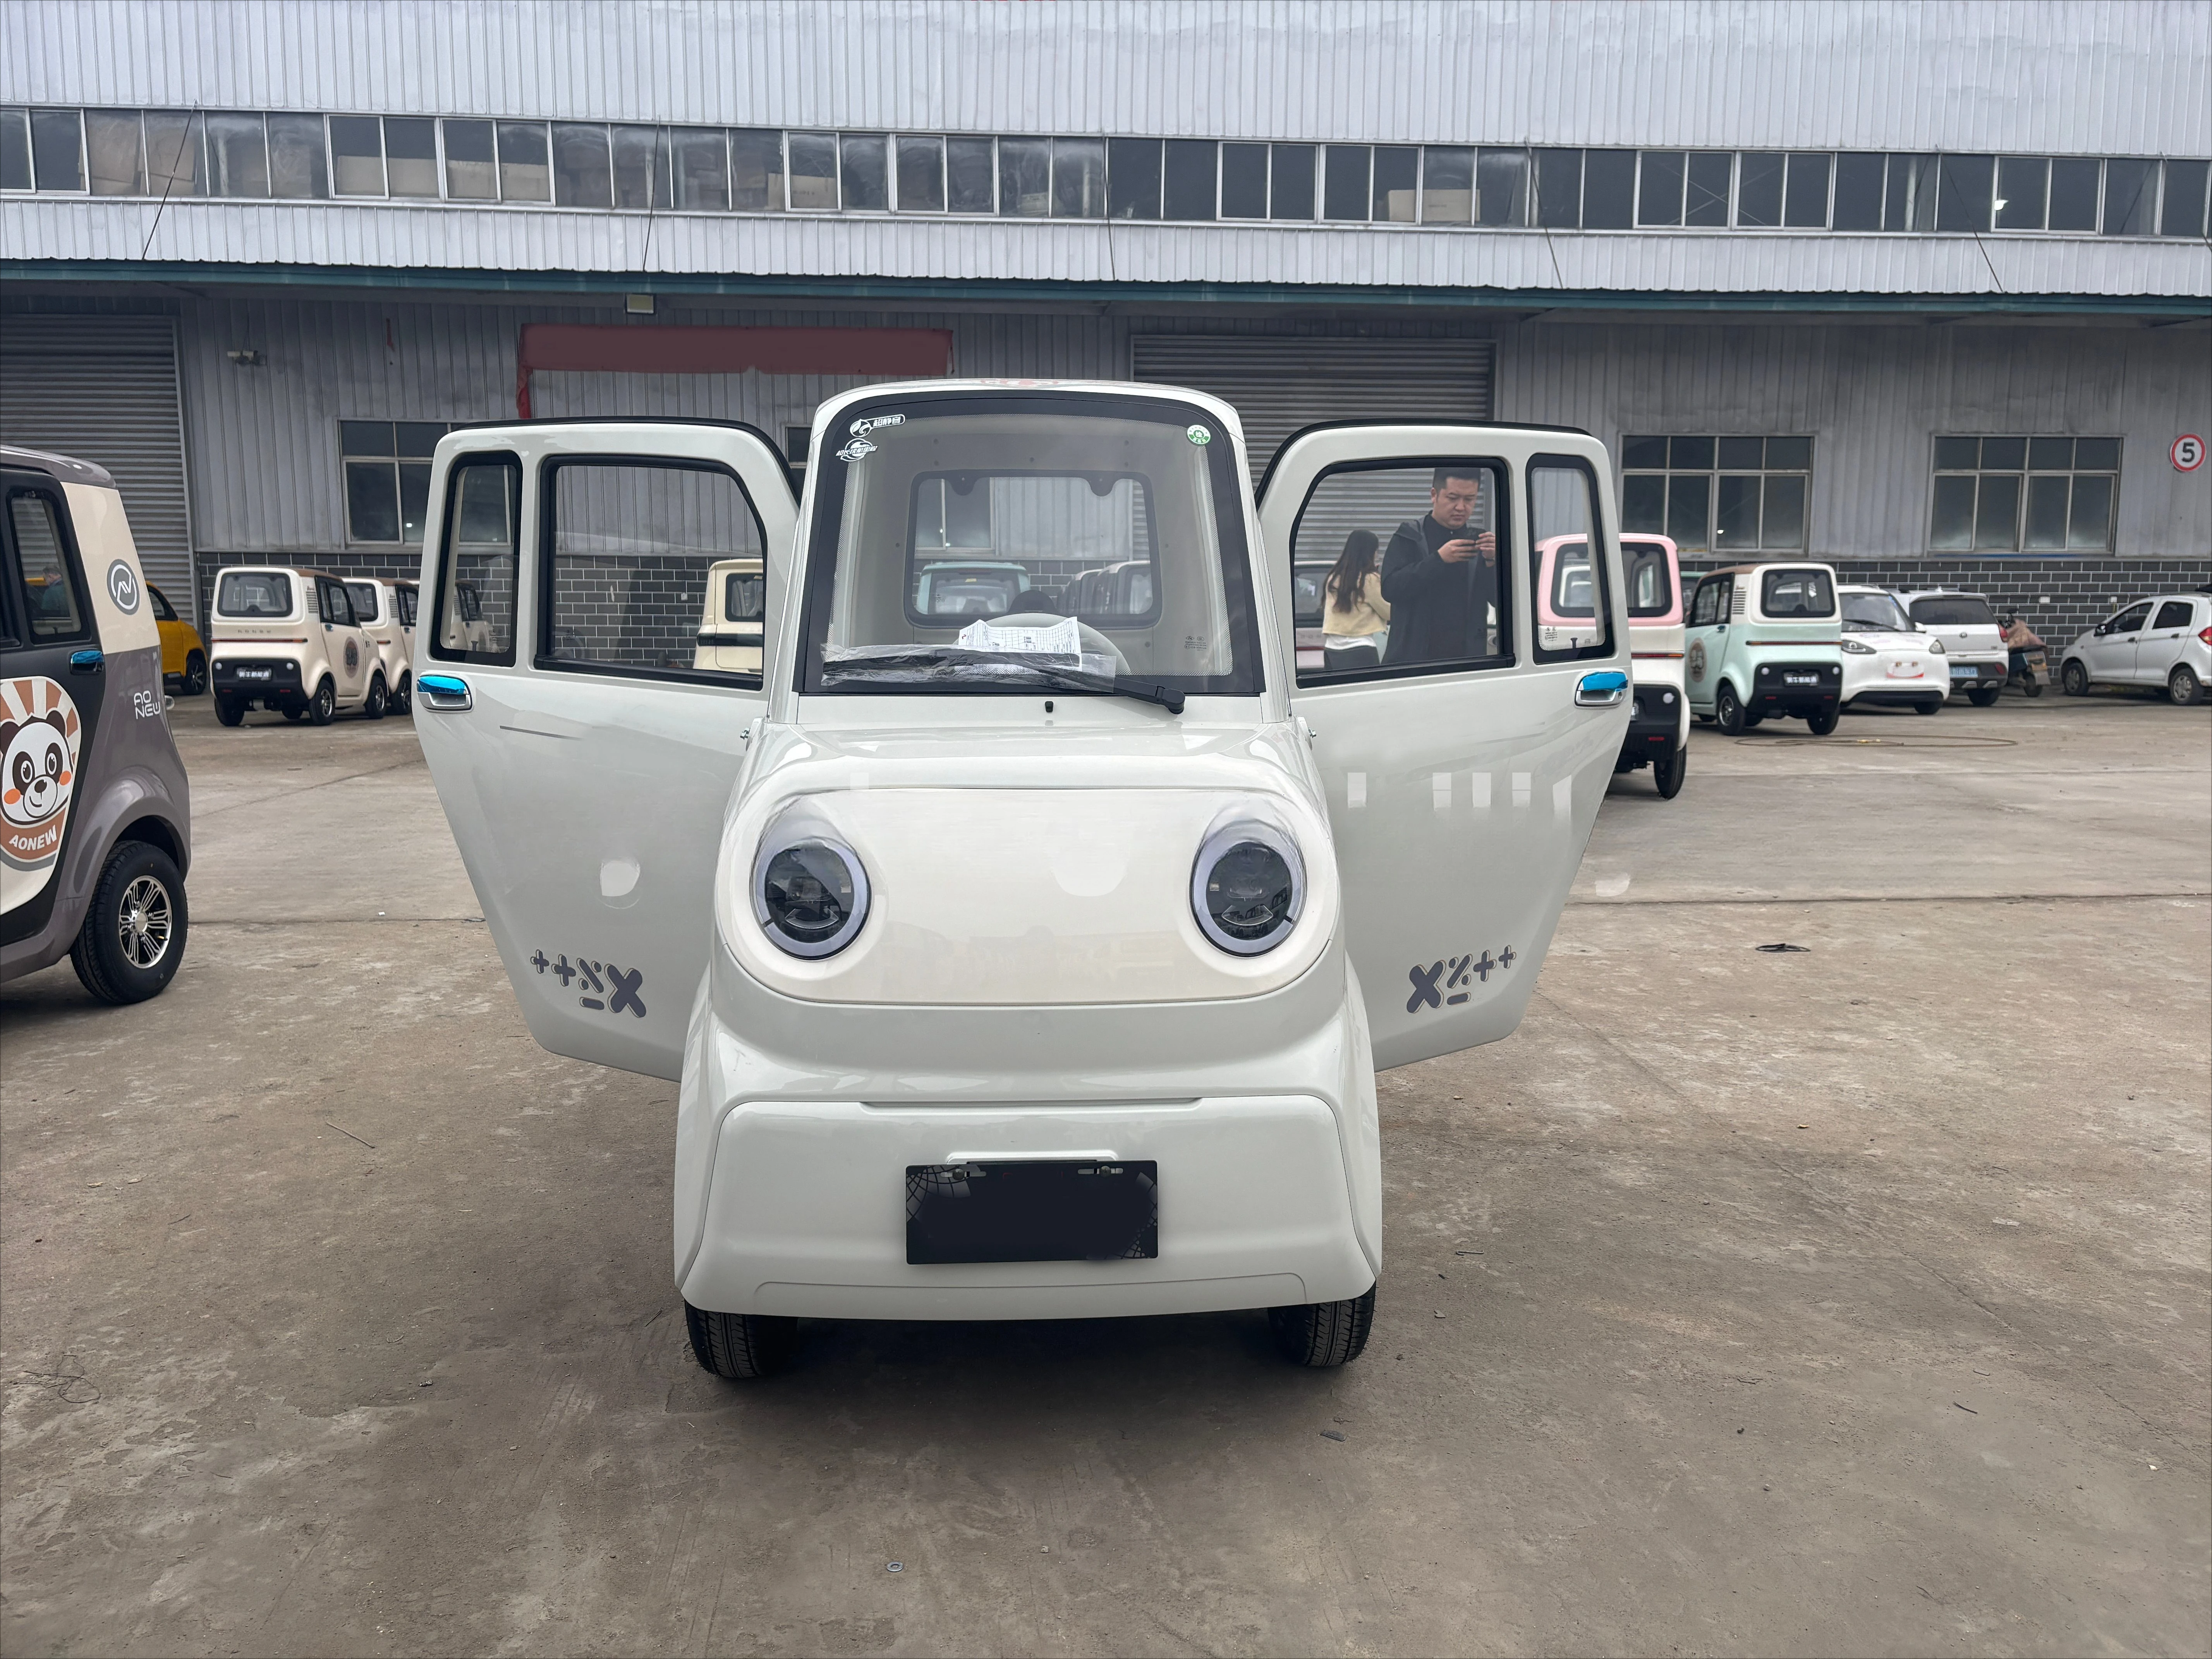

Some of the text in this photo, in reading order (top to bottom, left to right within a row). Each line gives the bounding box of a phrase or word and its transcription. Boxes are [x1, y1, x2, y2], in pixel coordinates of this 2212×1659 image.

[873, 416, 901, 427] 超静音
[2182, 442, 2195, 462] 5
[134, 690, 151, 706] AO
[135, 701, 161, 720] NEW
[9, 824, 57, 850] AONEW
